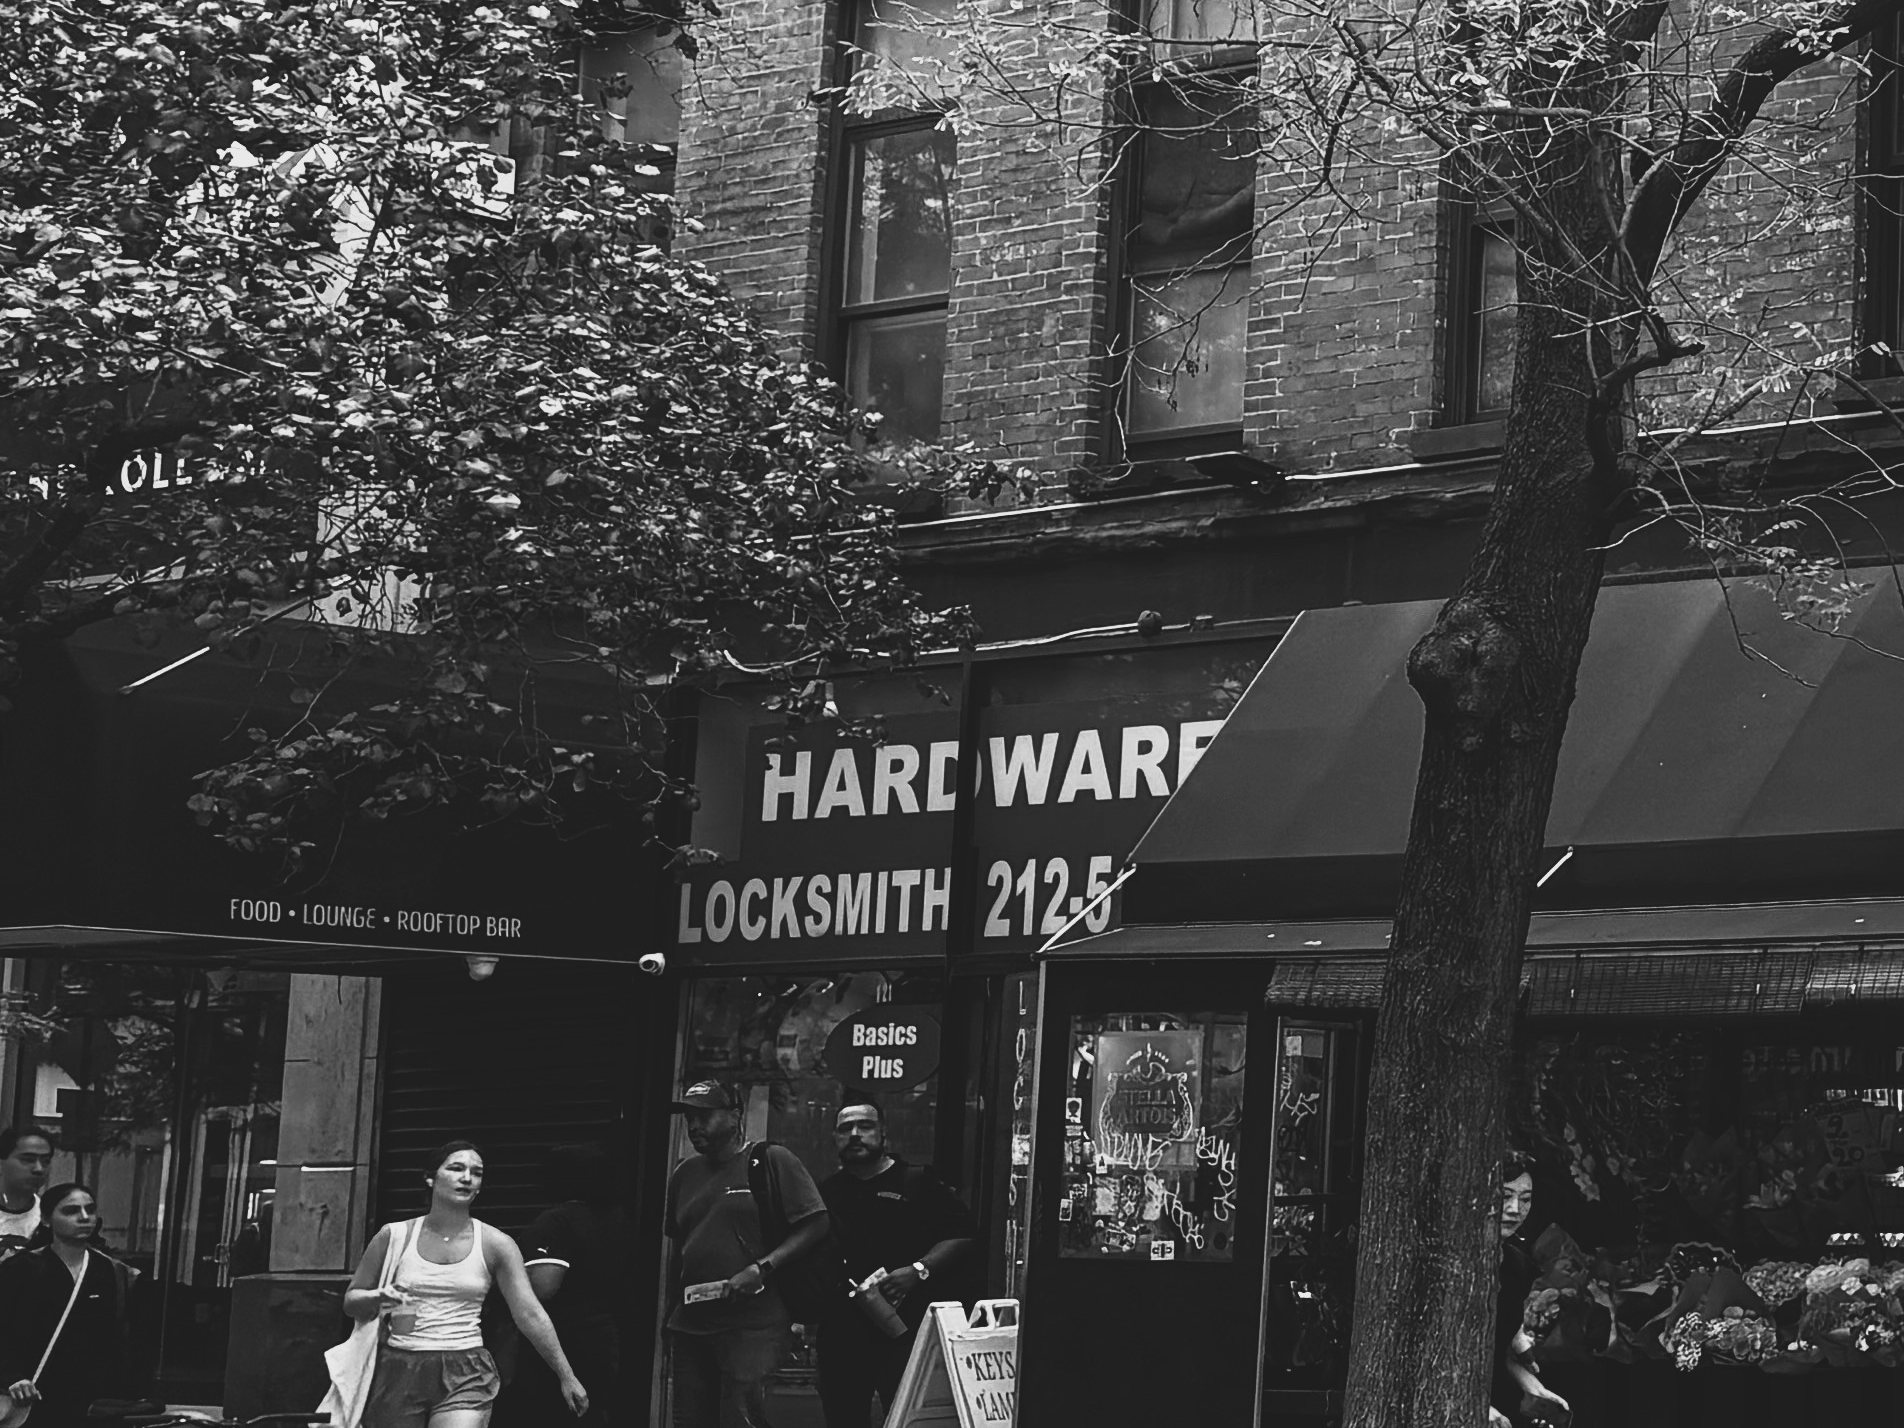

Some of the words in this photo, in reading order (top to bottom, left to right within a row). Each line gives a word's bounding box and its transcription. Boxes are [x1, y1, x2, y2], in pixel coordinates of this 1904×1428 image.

[229, 898, 282, 923] FOOD
[303, 902, 377, 930] LOUNGE
[397, 910, 481, 936] ROOFTOP
[486, 916, 522, 939] BAR
[678, 867, 951, 943] LOCKSMITH
[852, 1022, 917, 1046] Basics
[862, 1055, 904, 1079] Plus
[971, 1351, 1016, 1381] KEYS
